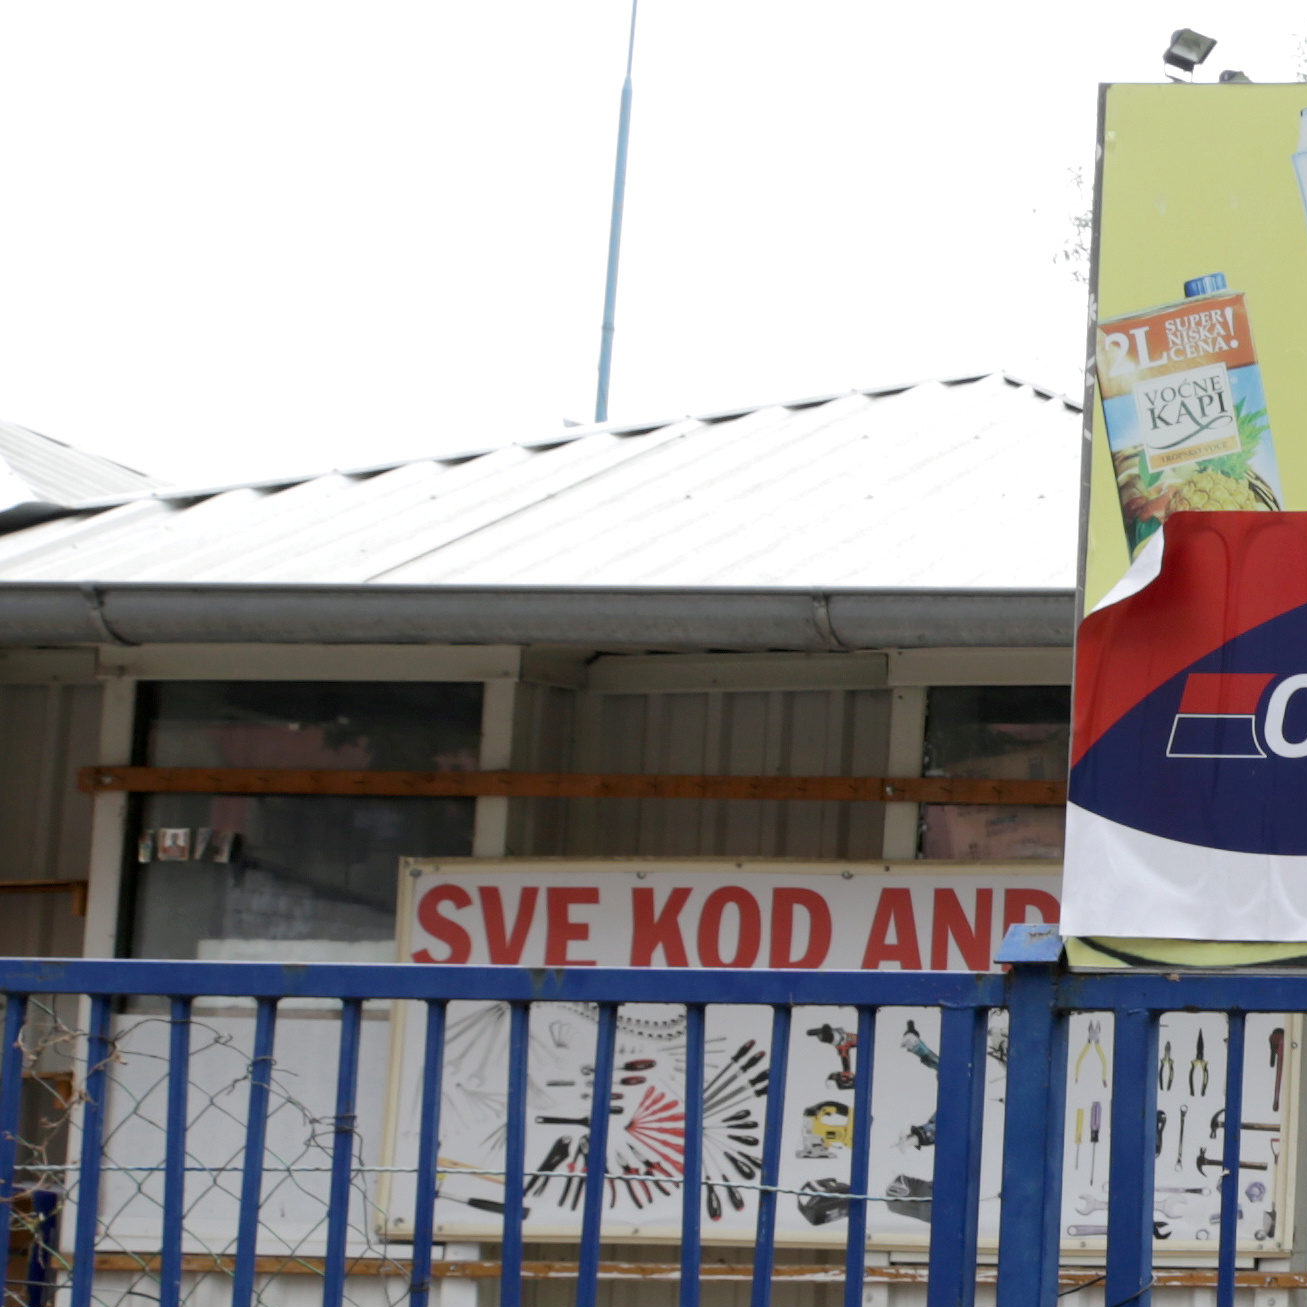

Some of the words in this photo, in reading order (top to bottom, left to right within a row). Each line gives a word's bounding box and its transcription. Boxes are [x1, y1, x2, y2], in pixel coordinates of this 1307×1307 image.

[1164, 309, 1225, 334] SUPER
[1166, 322, 1227, 348] NISKA
[1104, 326, 1168, 377] 2L
[1147, 391, 1232, 432] KAPI
[411, 884, 599, 966] SVE
[629, 886, 832, 969] KOD
